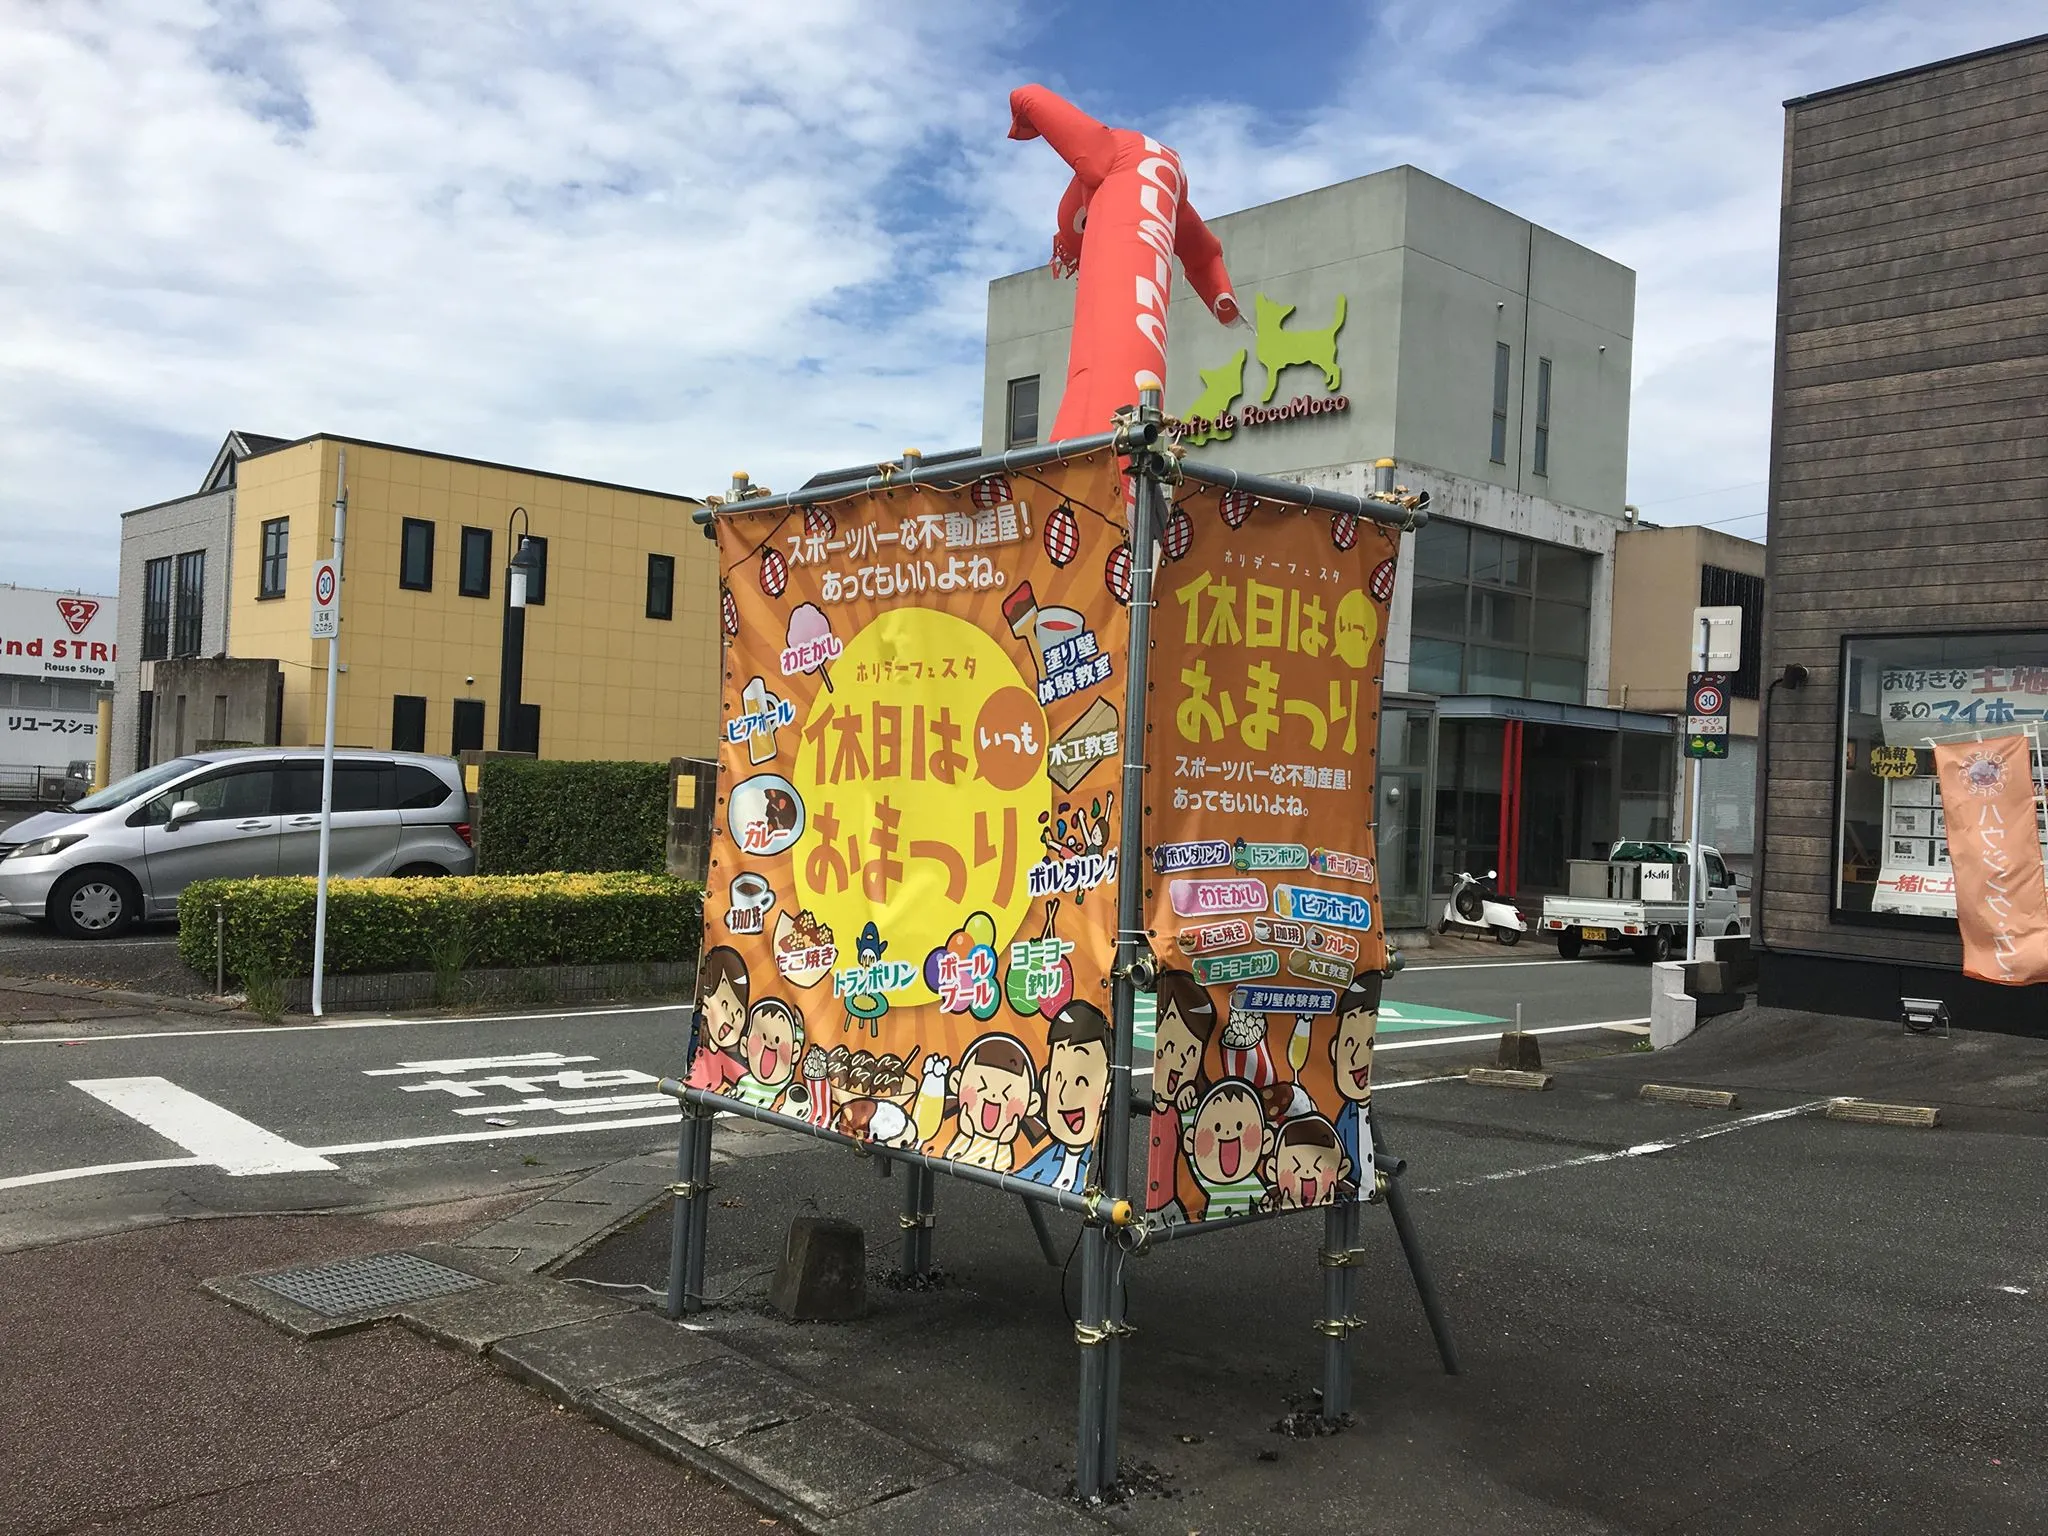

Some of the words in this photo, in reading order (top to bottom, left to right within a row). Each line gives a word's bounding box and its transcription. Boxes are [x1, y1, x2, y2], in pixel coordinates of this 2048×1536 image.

[1212, 409, 1237, 430] de
[1241, 395, 1350, 427] RocoMoco
[821, 554, 1005, 602] あってもいいよね。
[1224, 549, 1342, 584] ホリデーフェスタ
[319, 576, 331, 594] 30
[69, 604, 86, 623] 2
[1175, 570, 1329, 658] 休日は
[1339, 615, 1369, 642] いつ
[0, 637, 43, 657] nd
[52, 639, 118, 663] STR
[782, 636, 843, 673] わたがし
[1045, 632, 1099, 674] 塗り壁
[44, 662, 77, 673] Reuse
[79, 665, 106, 676] Shop
[855, 655, 978, 684] ホリデーフェスタ
[1038, 654, 1113, 705] 体験教室
[1175, 659, 1359, 755] おまつり
[1700, 694, 1716, 707] 30
[1888, 697, 2048, 725] 夢のマイホー
[727, 701, 795, 742] ビアホール
[803, 699, 970, 788] 休日は
[979, 721, 1039, 756] いつも
[1048, 730, 1120, 767] 木工教室
[1173, 787, 1310, 817] あってもいいよね。
[743, 825, 790, 850] カレー
[805, 795, 1019, 909] おまつり
[1166, 843, 1228, 867] ボルダリング
[1029, 850, 1119, 894] ボルダリング
[1644, 869, 1670, 880] Asahi
[1200, 882, 1261, 908] わたがし
[1301, 894, 1365, 922] ビアホール
[731, 905, 762, 932] 珈琲
[1201, 924, 1246, 946] たこ焼き
[1274, 926, 1301, 943] 珈琲
[1326, 936, 1355, 953] カレー
[775, 945, 835, 973] たこ焼き
[940, 952, 991, 981] ボール
[1012, 940, 1075, 967] ヨーヨー
[1210, 956, 1274, 979] ヨーヨー釣り
[834, 963, 918, 997] トランポリン
[1027, 969, 1062, 997] 釣り
[1308, 959, 1349, 980] 木工教室
[939, 981, 993, 1012] プール
[1250, 991, 1333, 1009] 塗り壁体験教室
